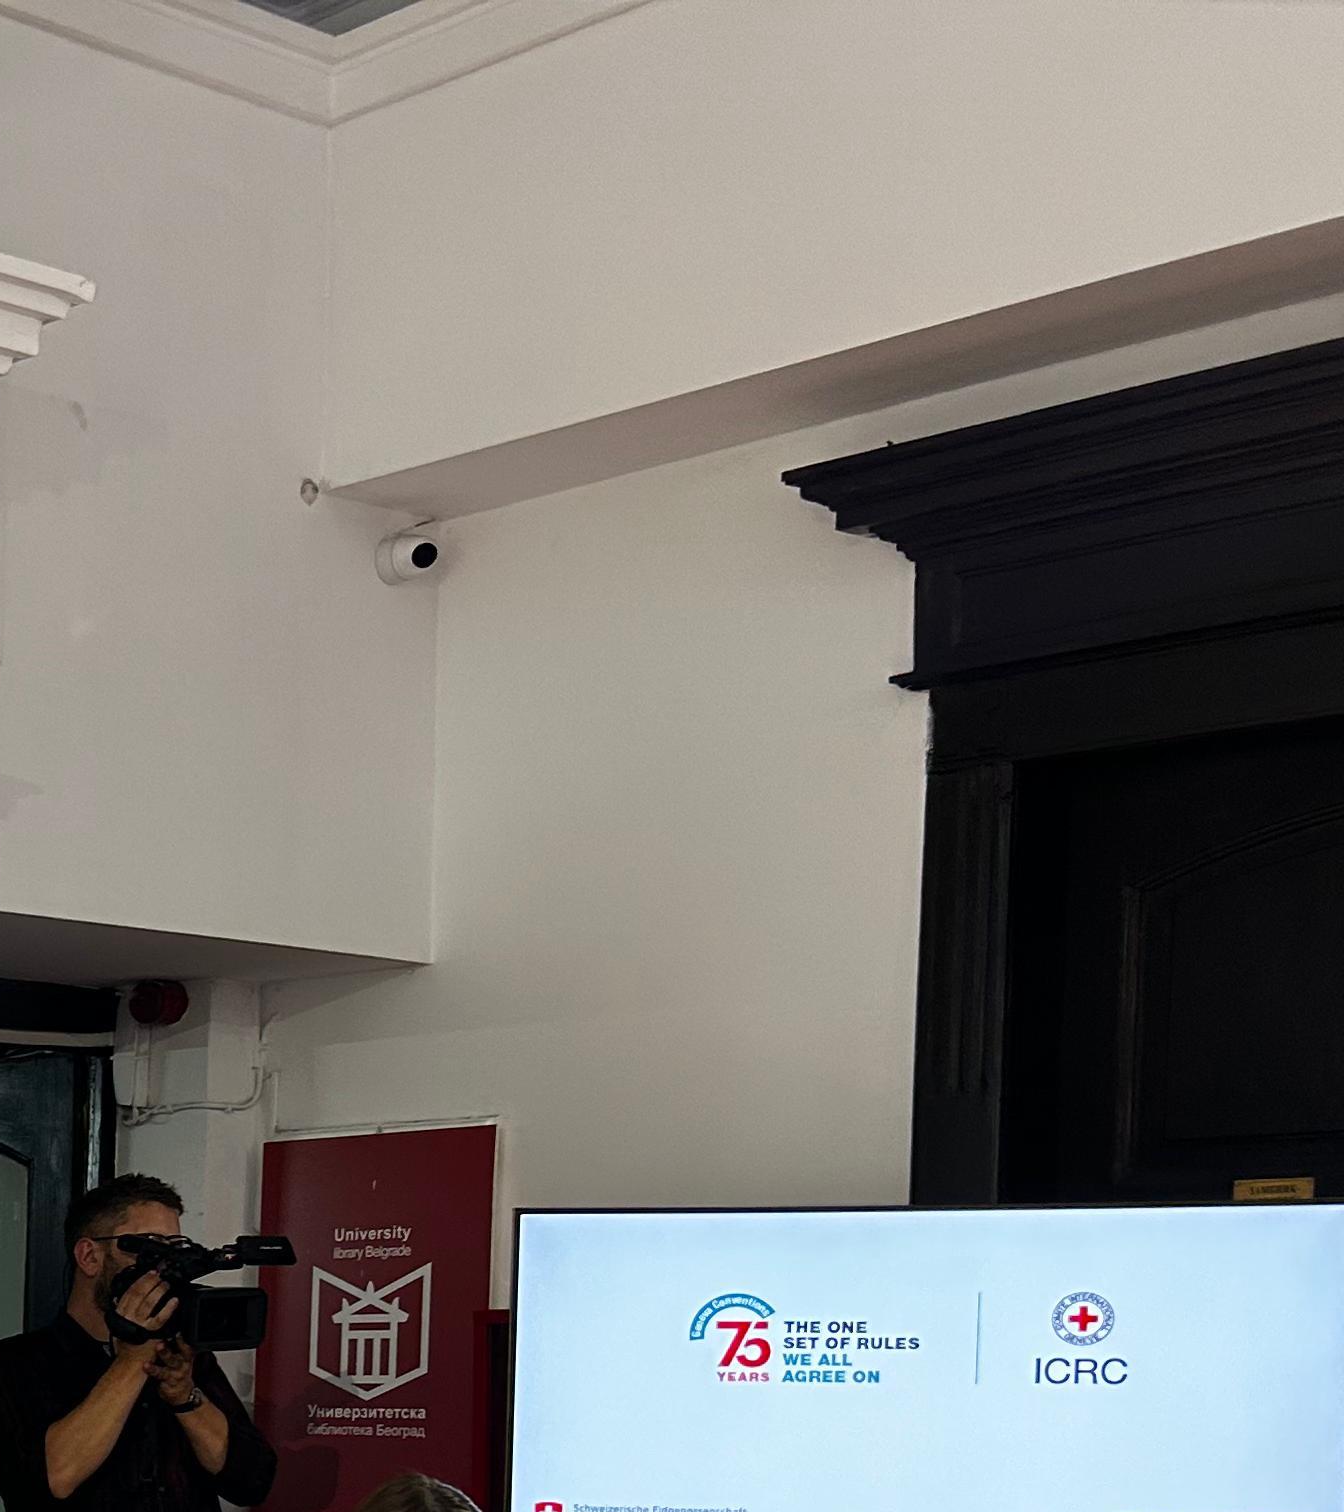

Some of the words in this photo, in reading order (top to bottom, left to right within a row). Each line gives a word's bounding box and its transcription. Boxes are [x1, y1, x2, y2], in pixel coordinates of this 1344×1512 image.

[334, 1225, 412, 1241] University
[365, 1245, 412, 1259] Belgrade
[784, 1321, 821, 1333] THE
[827, 1321, 867, 1333] ONE
[716, 1321, 772, 1368] 75
[783, 1337, 819, 1349] SET
[825, 1337, 851, 1350] OF
[857, 1337, 920, 1350] RULES
[783, 1354, 812, 1366] WE
[818, 1354, 852, 1366] ALL
[717, 1372, 769, 1382] YEARS
[782, 1371, 846, 1383] AGREE
[853, 1371, 880, 1383] ON
[1035, 1358, 1128, 1384] ICRC
[308, 1404, 426, 1421] Универзитетска
[376, 1424, 426, 1438] Београд
